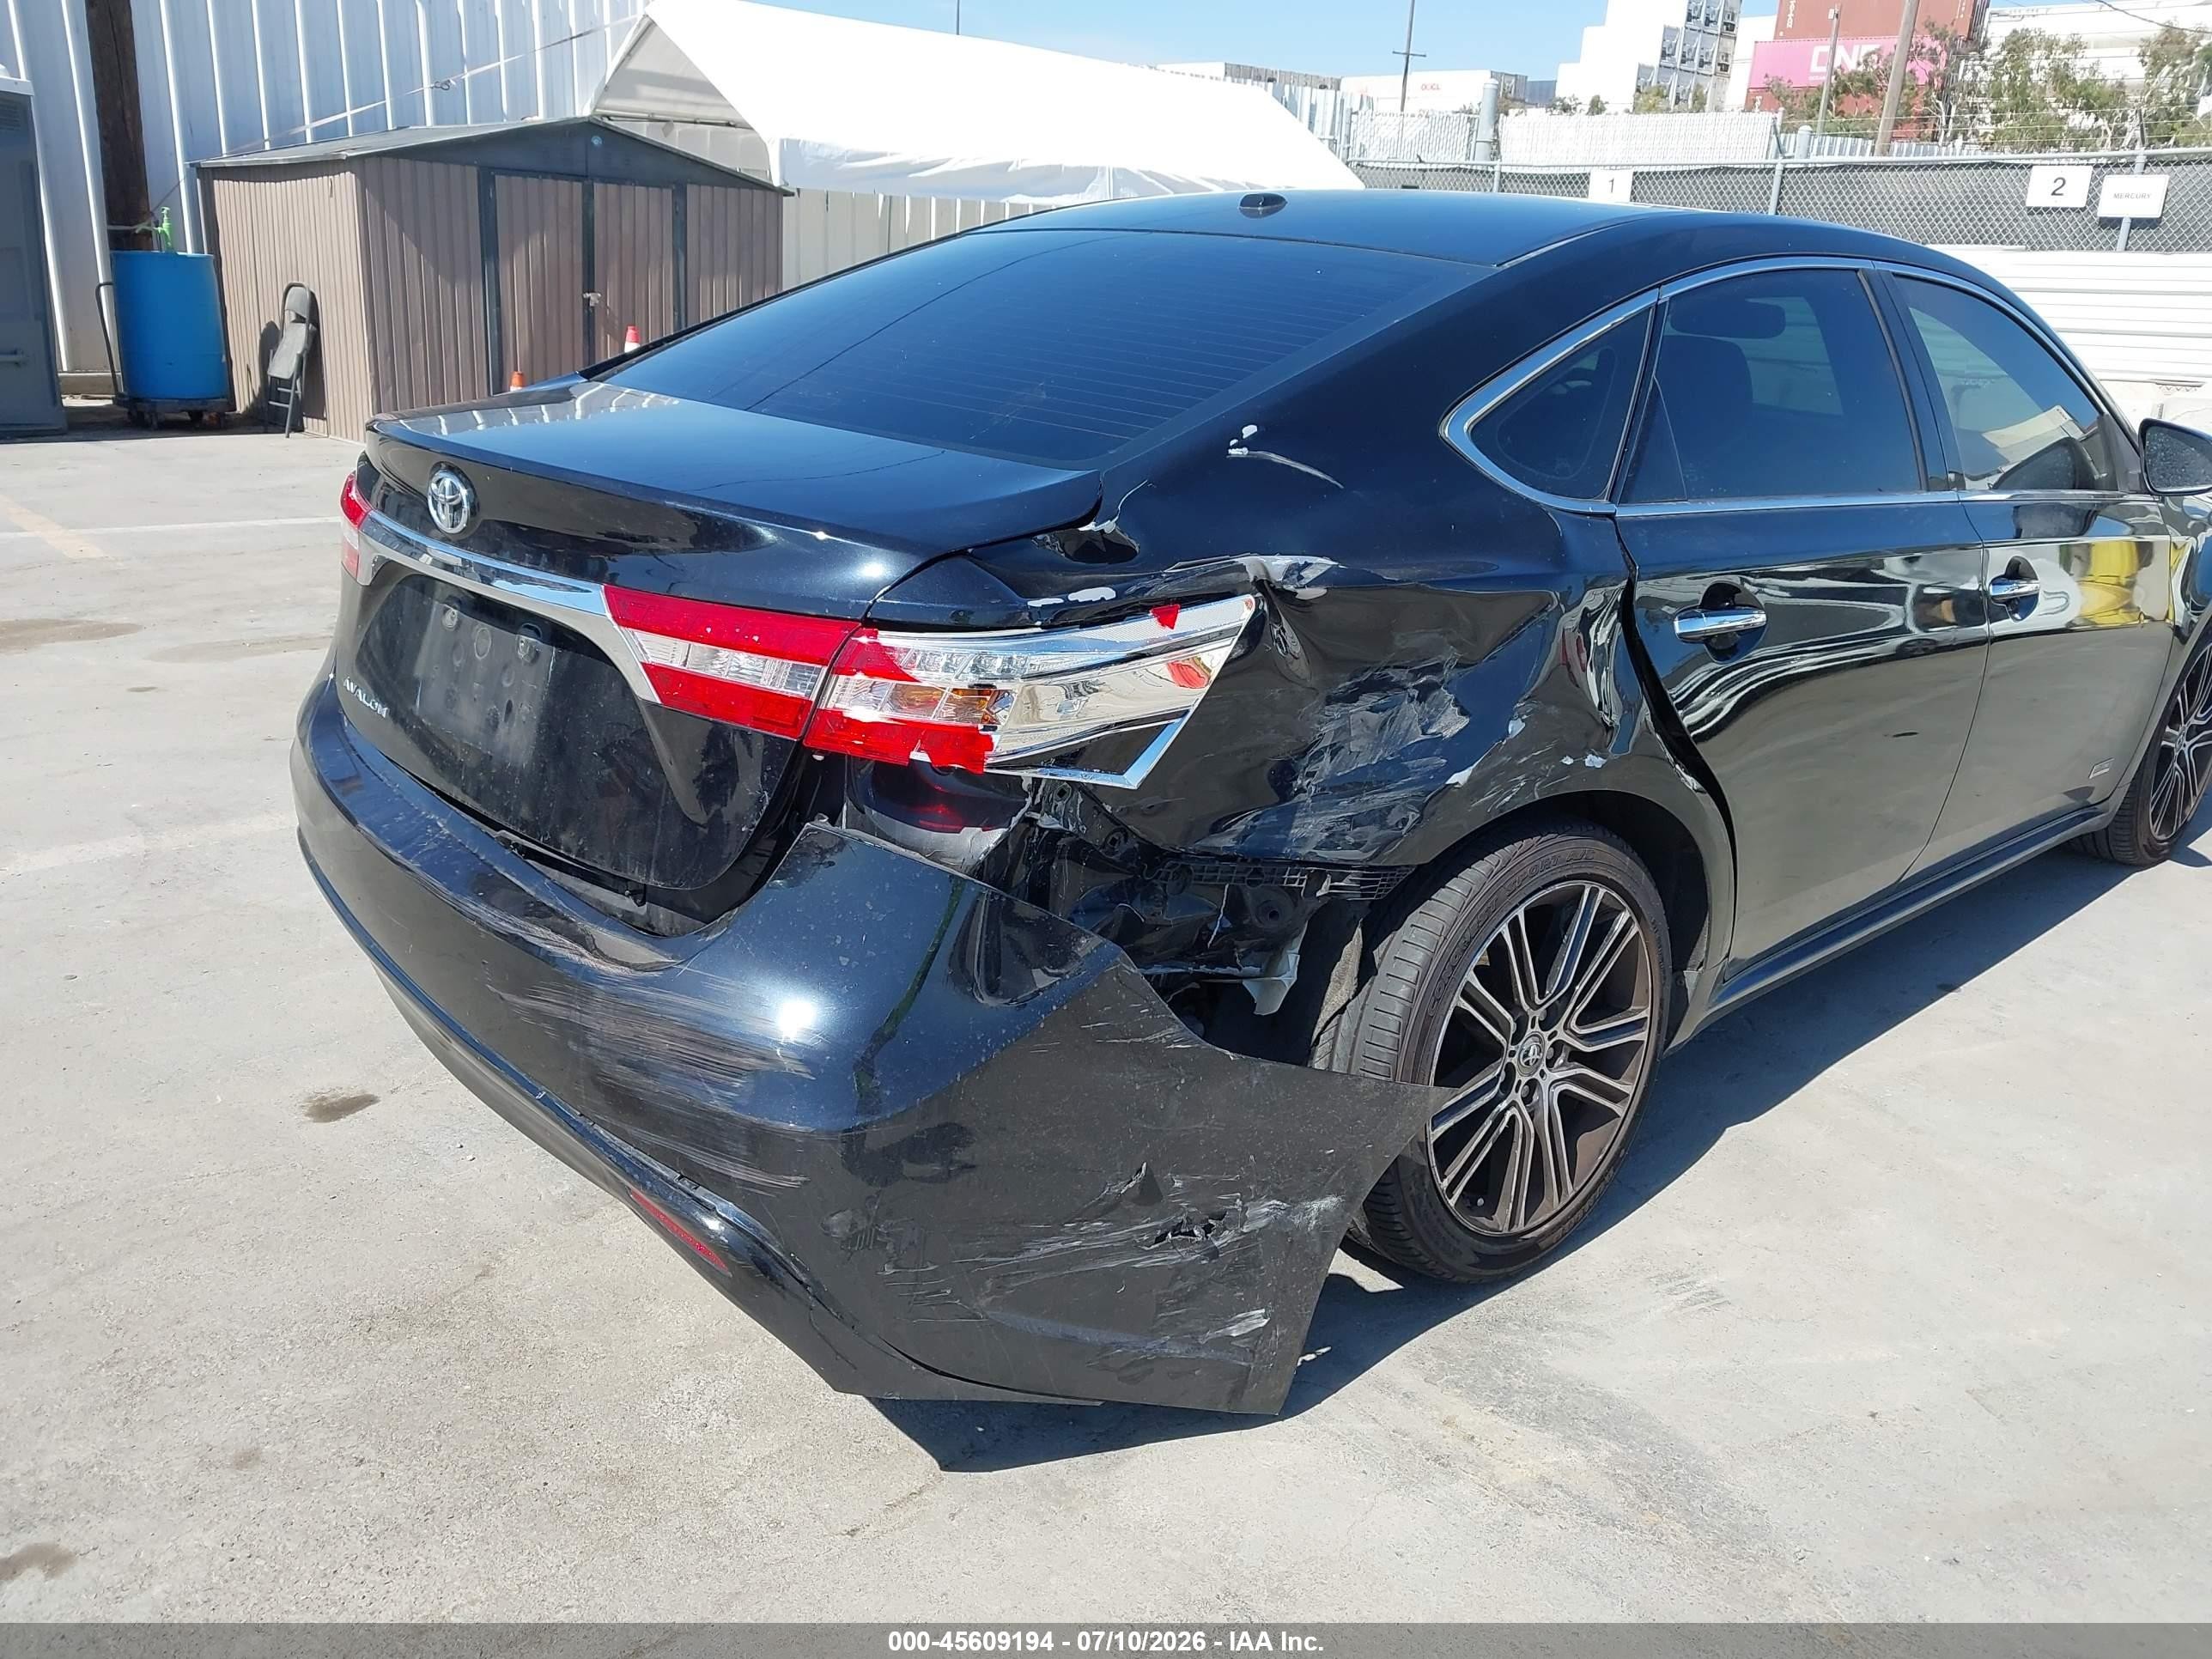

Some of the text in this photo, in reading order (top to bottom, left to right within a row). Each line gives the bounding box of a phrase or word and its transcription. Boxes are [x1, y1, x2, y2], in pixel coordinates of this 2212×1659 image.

[1608, 177, 1614, 193] 1
[2051, 177, 2067, 196] 2
[2113, 191, 2151, 200] MERCURY
[343, 676, 389, 719] AVALON
